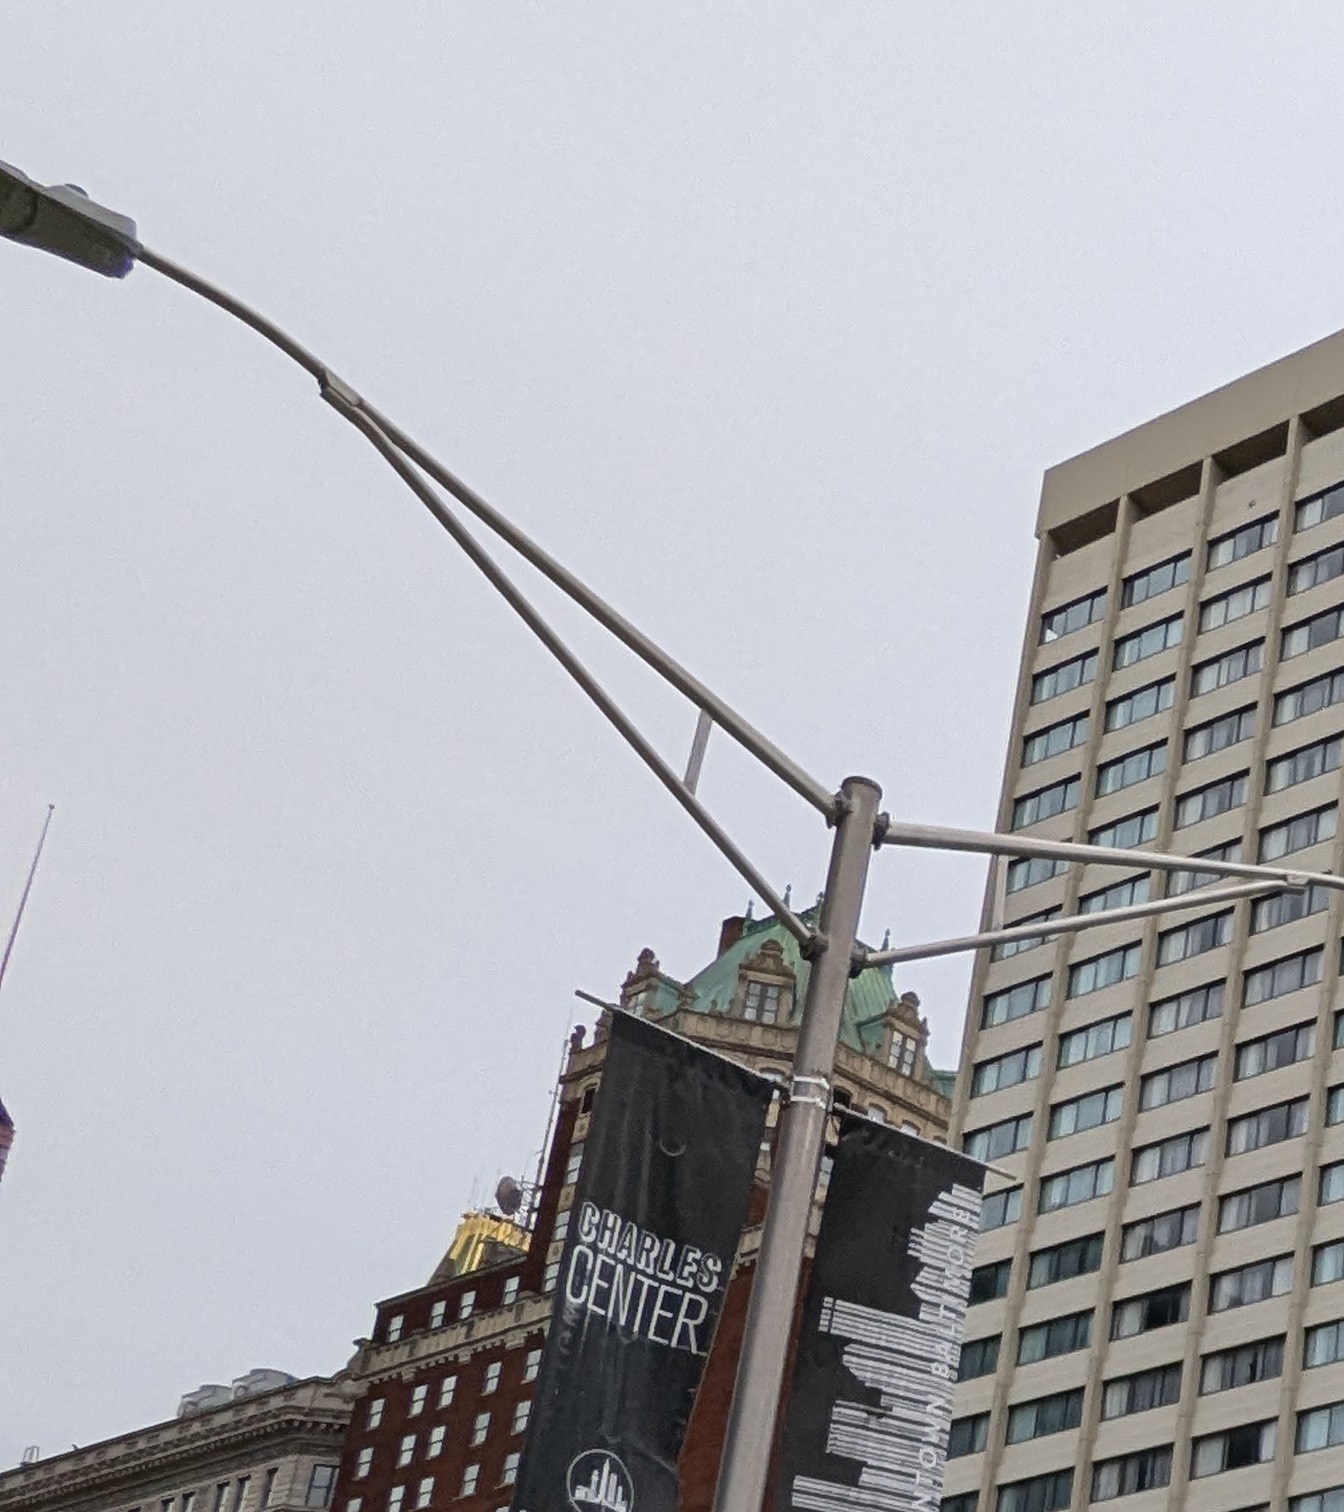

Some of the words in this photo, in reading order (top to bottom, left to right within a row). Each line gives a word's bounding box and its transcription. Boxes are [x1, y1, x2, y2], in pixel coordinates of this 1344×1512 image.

[566, 1244, 709, 1355] CENTER
[577, 1201, 722, 1293] CHARLES
[931, 1207, 971, 1379] BALTIMORE
